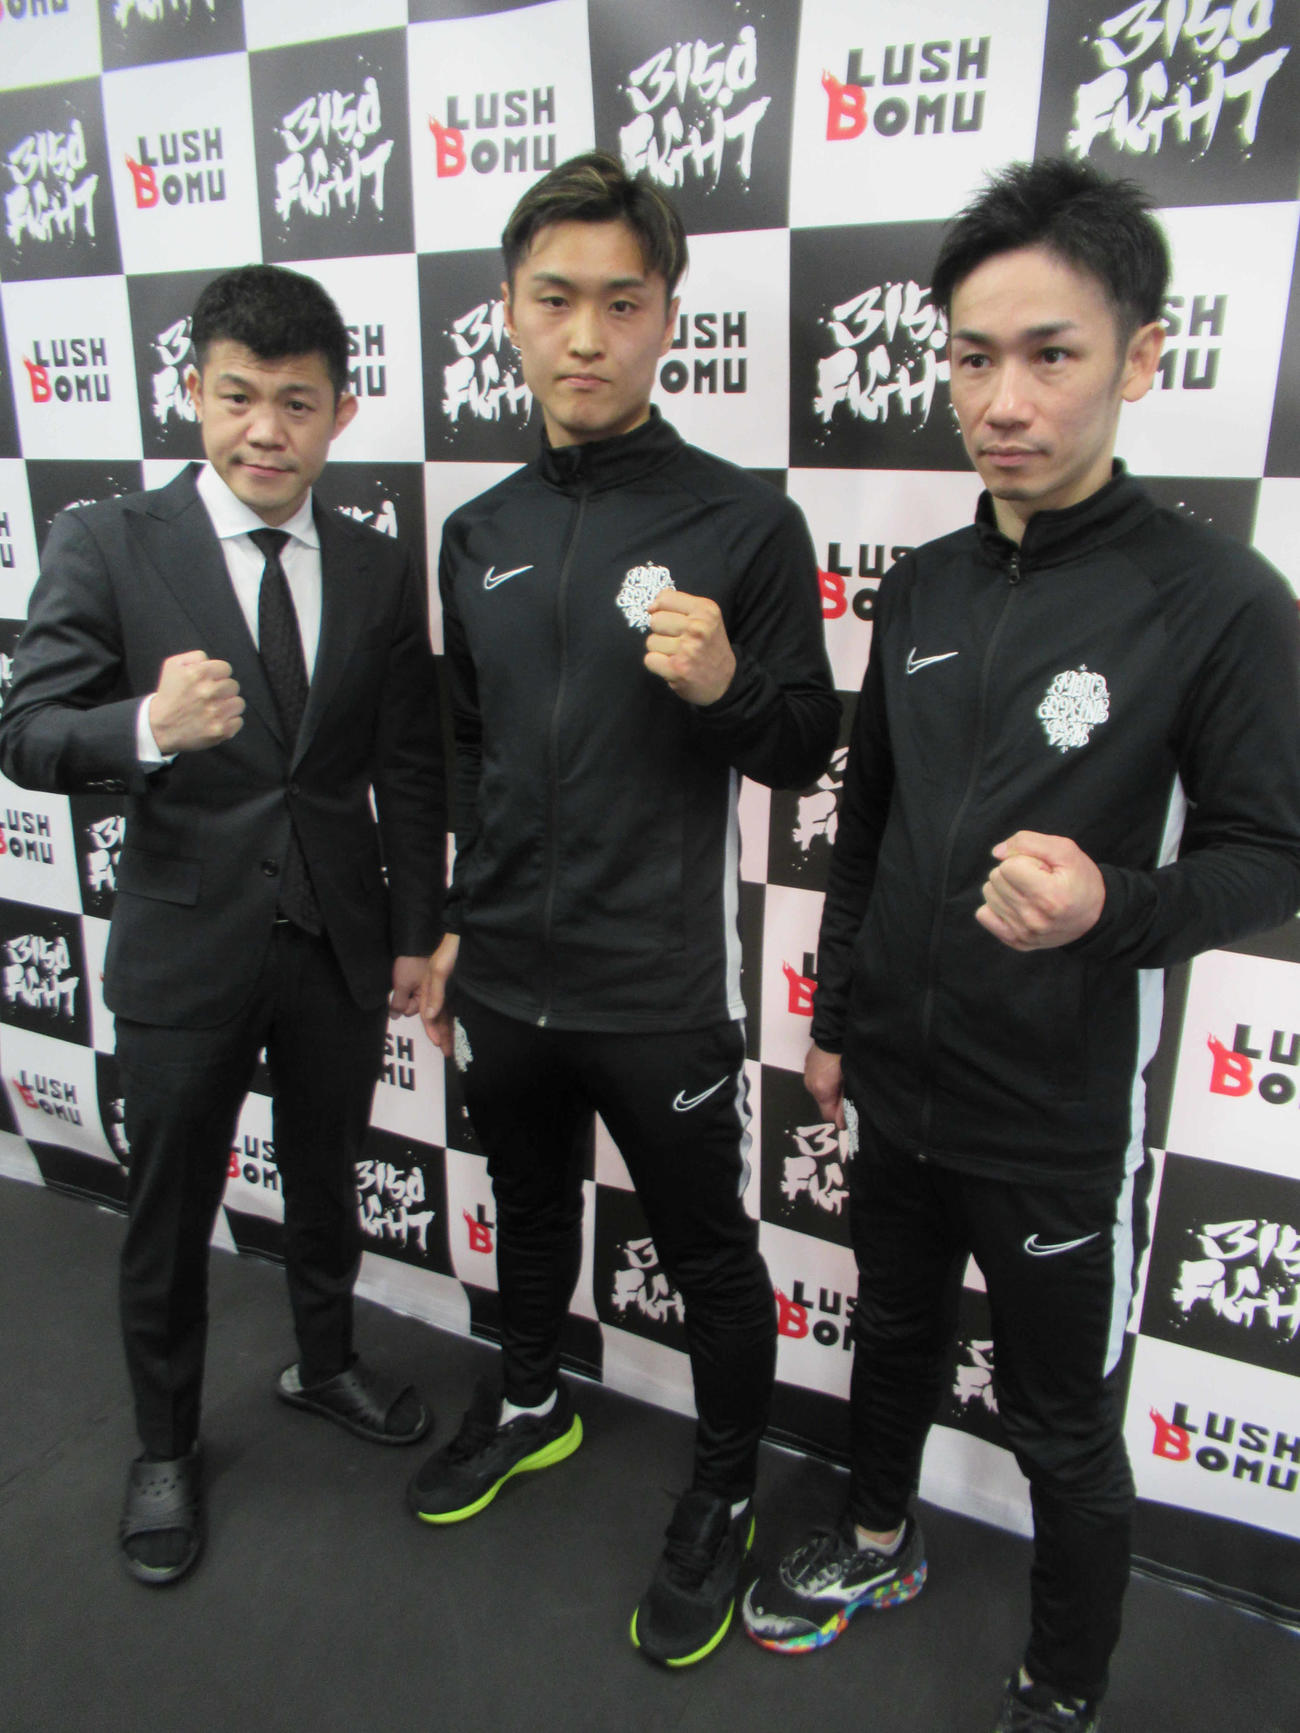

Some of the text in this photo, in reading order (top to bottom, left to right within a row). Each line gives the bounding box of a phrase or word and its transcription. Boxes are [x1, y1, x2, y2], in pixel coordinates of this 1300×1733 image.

[846, 35, 992, 87] LUSH
[446, 85, 555, 130] LUSH
[821, 67, 987, 141] BOMU
[1067, 46, 1290, 160] FIGHT
[137, 127, 223, 167] LUSH
[428, 112, 557, 178] BOMU
[619, 96, 772, 188] FIGHT
[125, 152, 227, 209] BOMU
[274, 140, 394, 222] FIGHT
[5, 174, 98, 246] FIGHT
[346, 324, 385, 356] SH
[670, 311, 747, 350] USH
[828, 280, 949, 348] 315
[1160, 294, 1229, 336] SH
[22, 354, 111, 403] BOMU
[33, 337, 107, 368] LUSH
[659, 358, 747, 394] OMU
[1157, 348, 1222, 390] MU
[347, 365, 387, 397] MU
[442, 353, 533, 422] FIGH
[817, 566, 880, 621] BO
[0, 808, 51, 838] USH
[5, 963, 80, 1017] FIGHT
[384, 1033, 415, 1062] SH
[1207, 1032, 1300, 1105] BO
[1232, 1023, 1300, 1067] LU
[12, 1076, 83, 1127] BOMU
[20, 1069, 78, 1105] LUSH
[781, 1156, 850, 1217] FIG
[357, 1191, 437, 1253] IGHT
[774, 1286, 858, 1351] BO
[1170, 1258, 1300, 1341] FIGH
[1149, 1405, 1300, 1493] BOMU
[1172, 1401, 1300, 1454] LUSH
